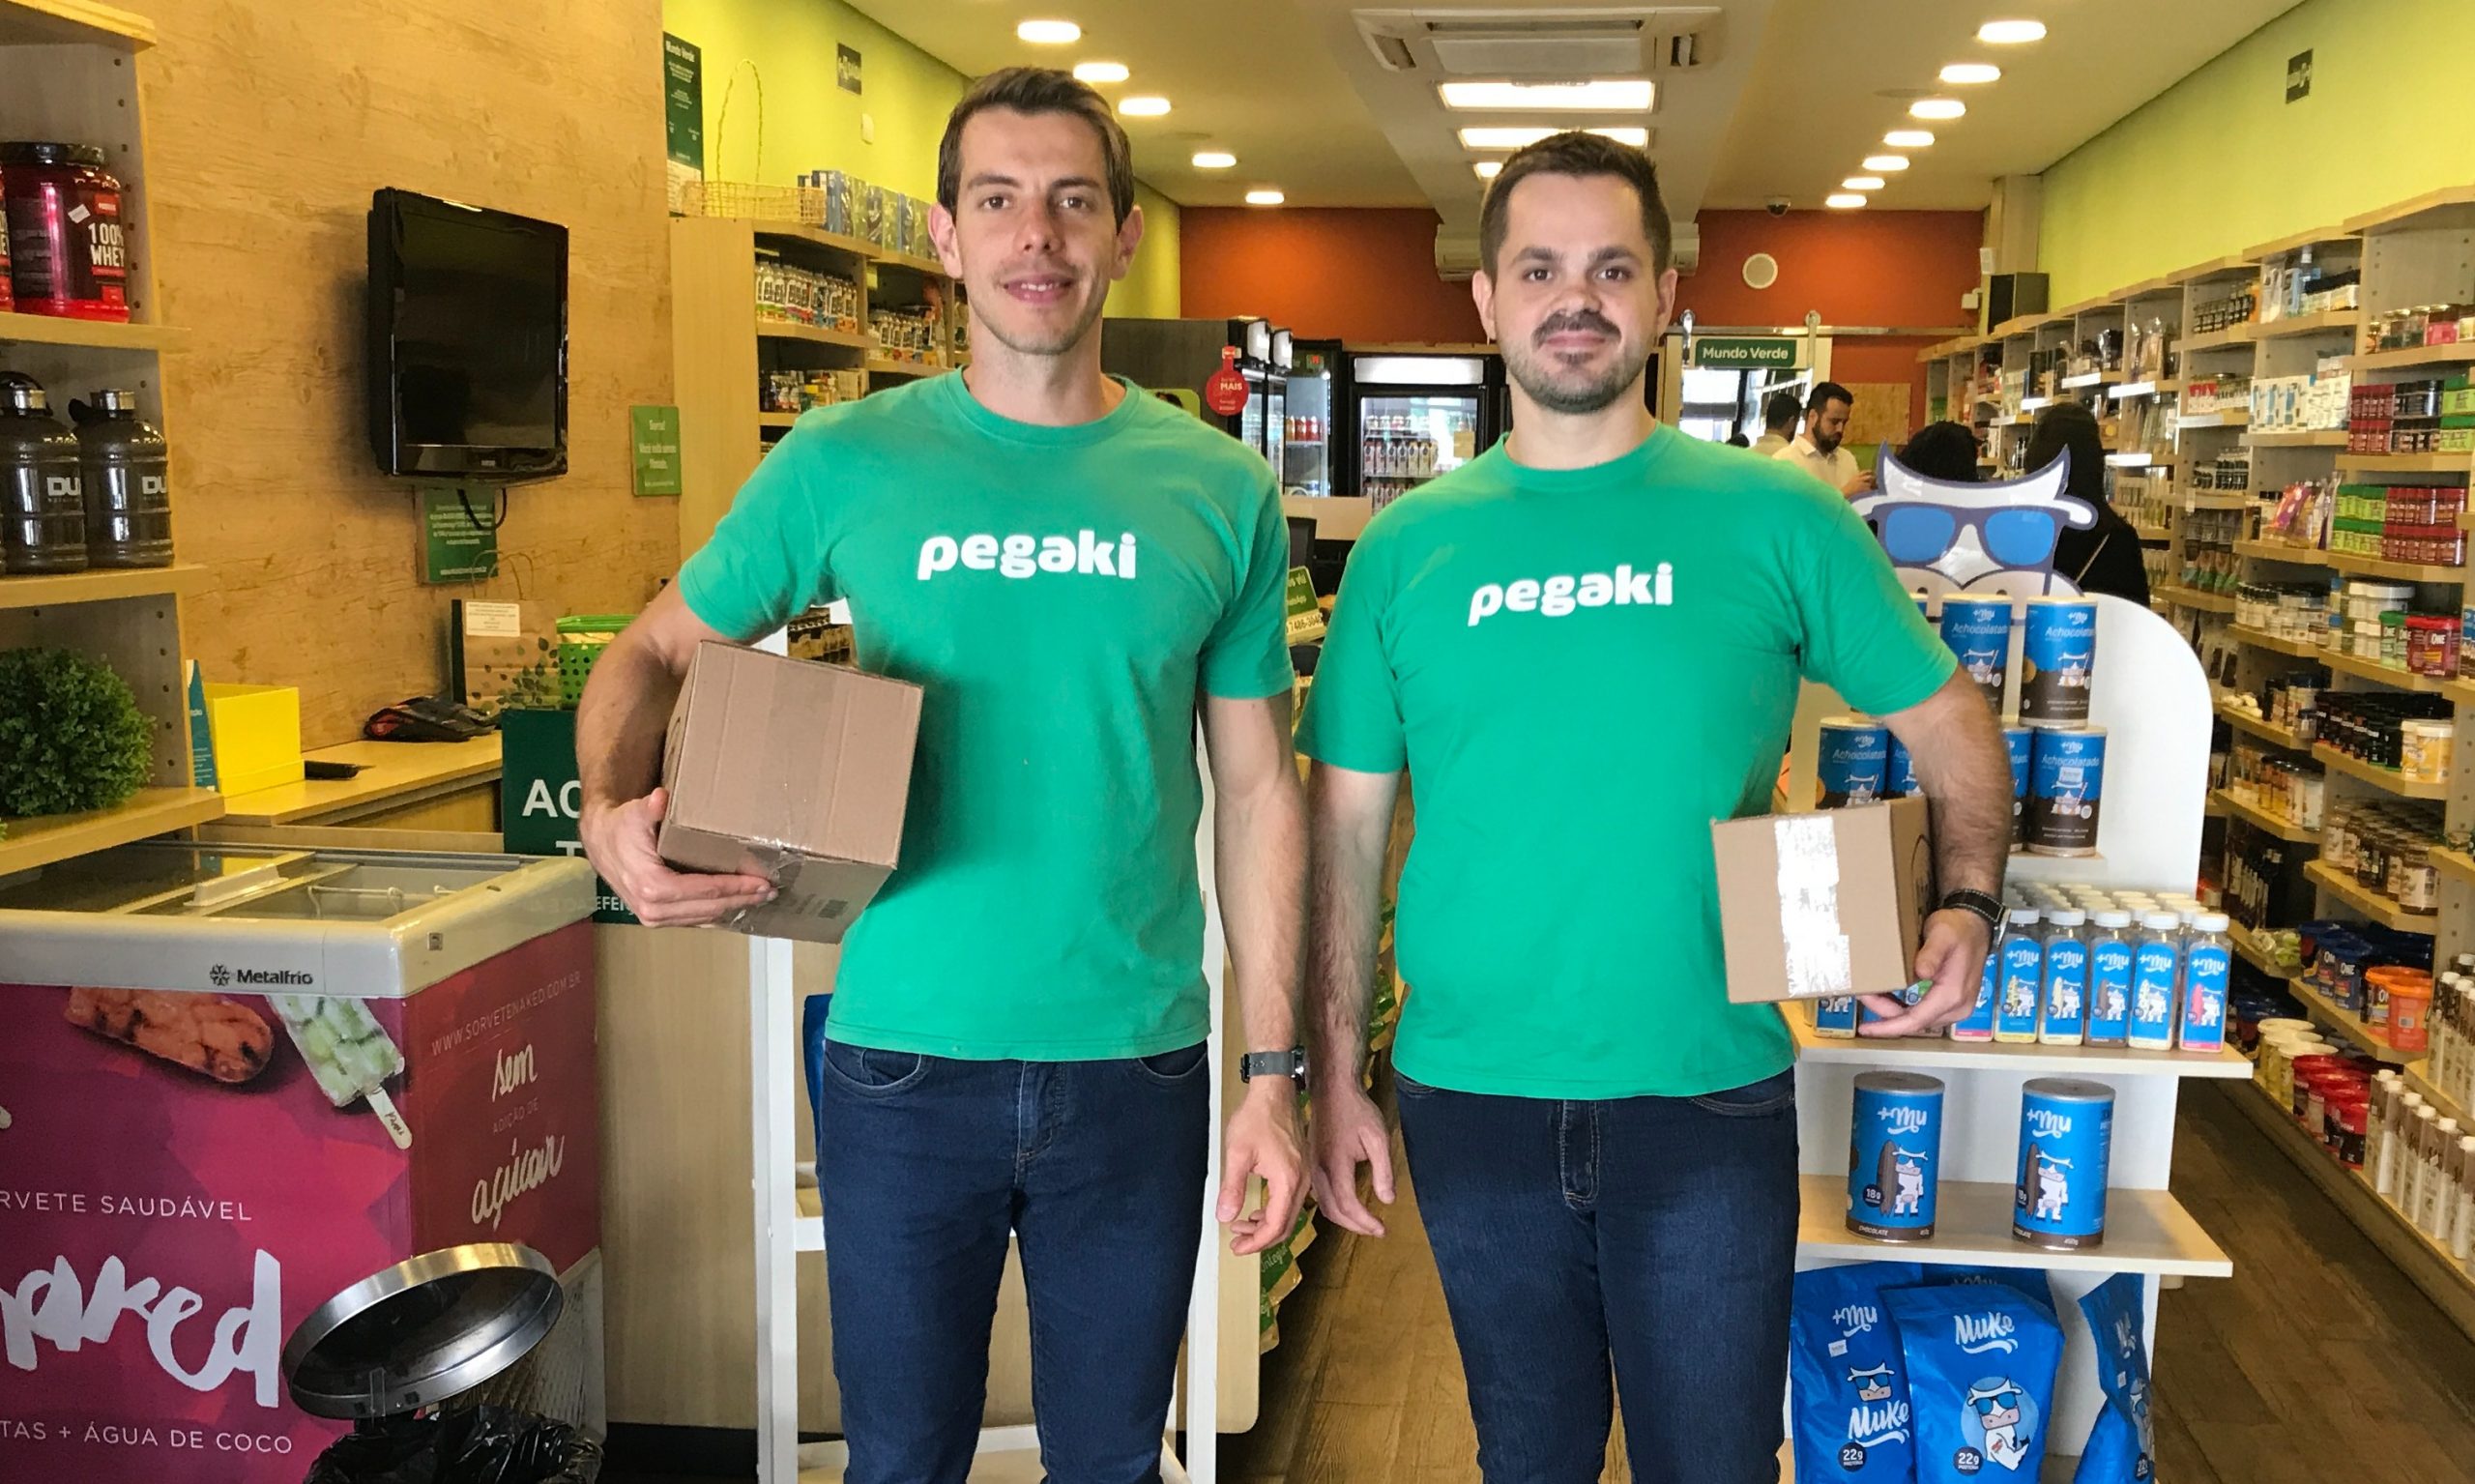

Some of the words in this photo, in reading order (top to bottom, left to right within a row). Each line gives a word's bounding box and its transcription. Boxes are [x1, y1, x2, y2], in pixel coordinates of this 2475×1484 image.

[90, 245, 125, 267] WHEY
[1703, 347, 1748, 359] Mundo
[1750, 347, 1789, 360] Verde
[917, 529, 1136, 581] pegaki
[1468, 562, 1673, 626] pegaki
[237, 969, 313, 985] Metalfrio
[492, 1044, 538, 1102] sem
[101, 1195, 252, 1221] SAUDÁVEL
[83, 1421, 159, 1447] ÁGUA
[170, 1429, 204, 1449] DE
[216, 1432, 292, 1454] COCO
[1958, 1452, 1980, 1466] 22g
